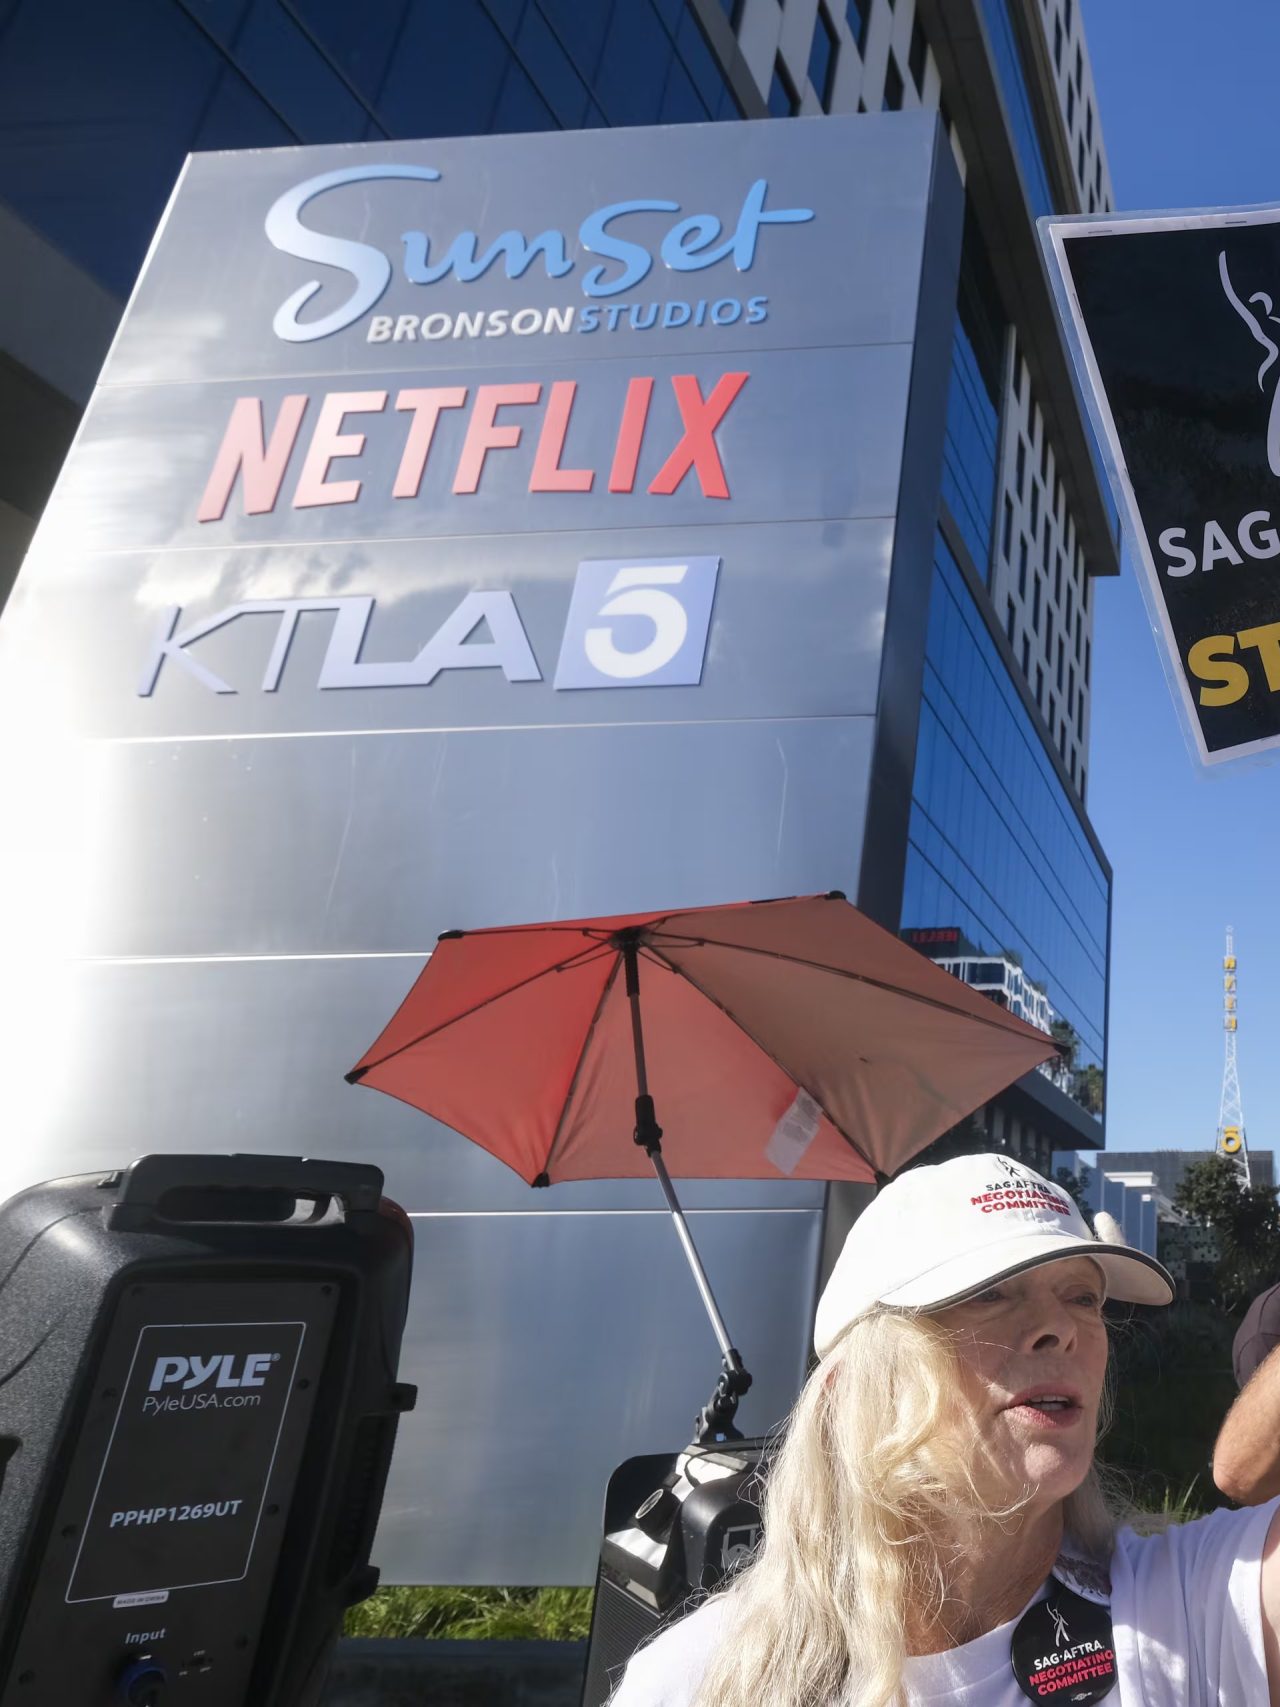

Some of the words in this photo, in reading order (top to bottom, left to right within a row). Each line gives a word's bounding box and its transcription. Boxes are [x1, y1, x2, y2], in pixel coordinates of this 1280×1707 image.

[197, 372, 751, 523] NETFLIX
[136, 589, 543, 698] KTLA
[583, 564, 690, 679] 5
[148, 1352, 272, 1392] PYLE
[142, 1391, 261, 1414] PyleUSA.com
[109, 1499, 243, 1528] PPHP1269UT
[124, 1627, 167, 1646] Input
[1029, 1650, 1114, 1687] NEGOTIATING
[1037, 1662, 1113, 1697] COMMITTEE
